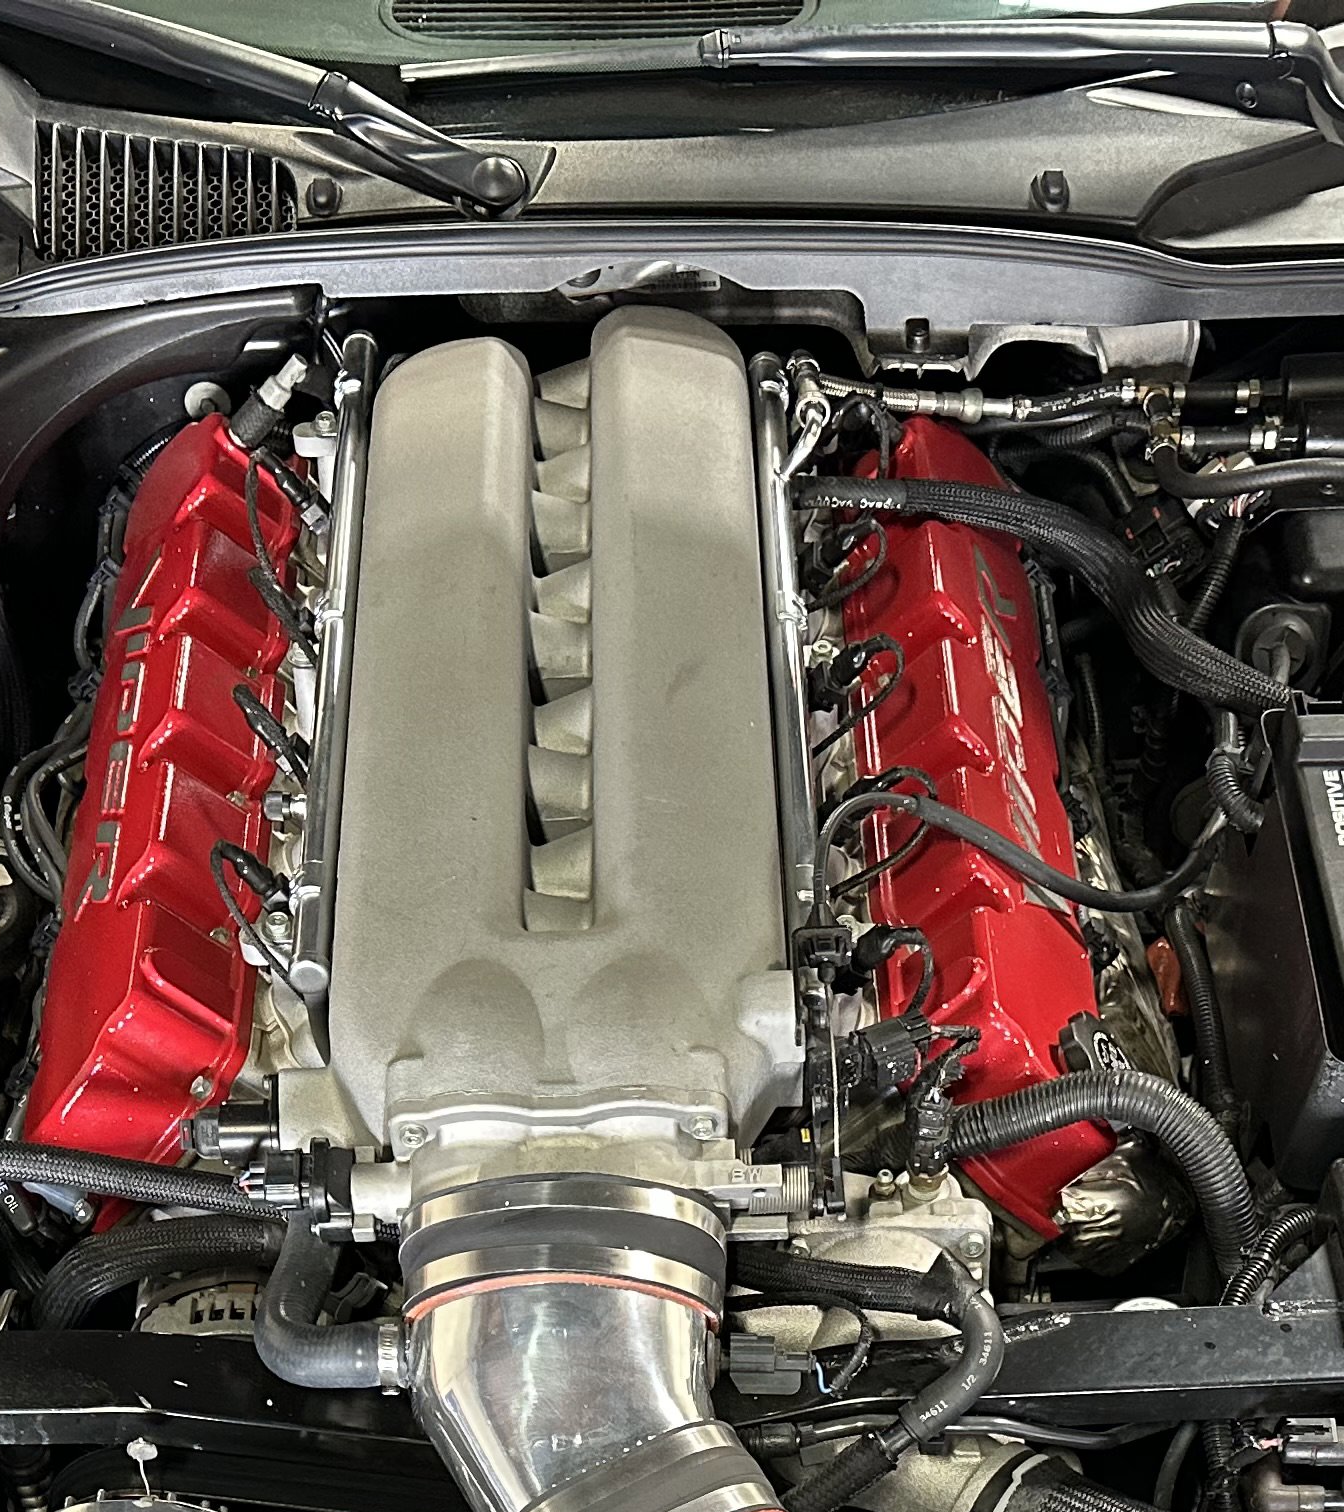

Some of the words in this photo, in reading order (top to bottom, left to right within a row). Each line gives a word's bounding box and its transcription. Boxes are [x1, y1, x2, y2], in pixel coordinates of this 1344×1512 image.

[74, 553, 163, 922] VIPER
[4, 1195, 18, 1214] OIL
[961, 1375, 976, 1390] 1/2
